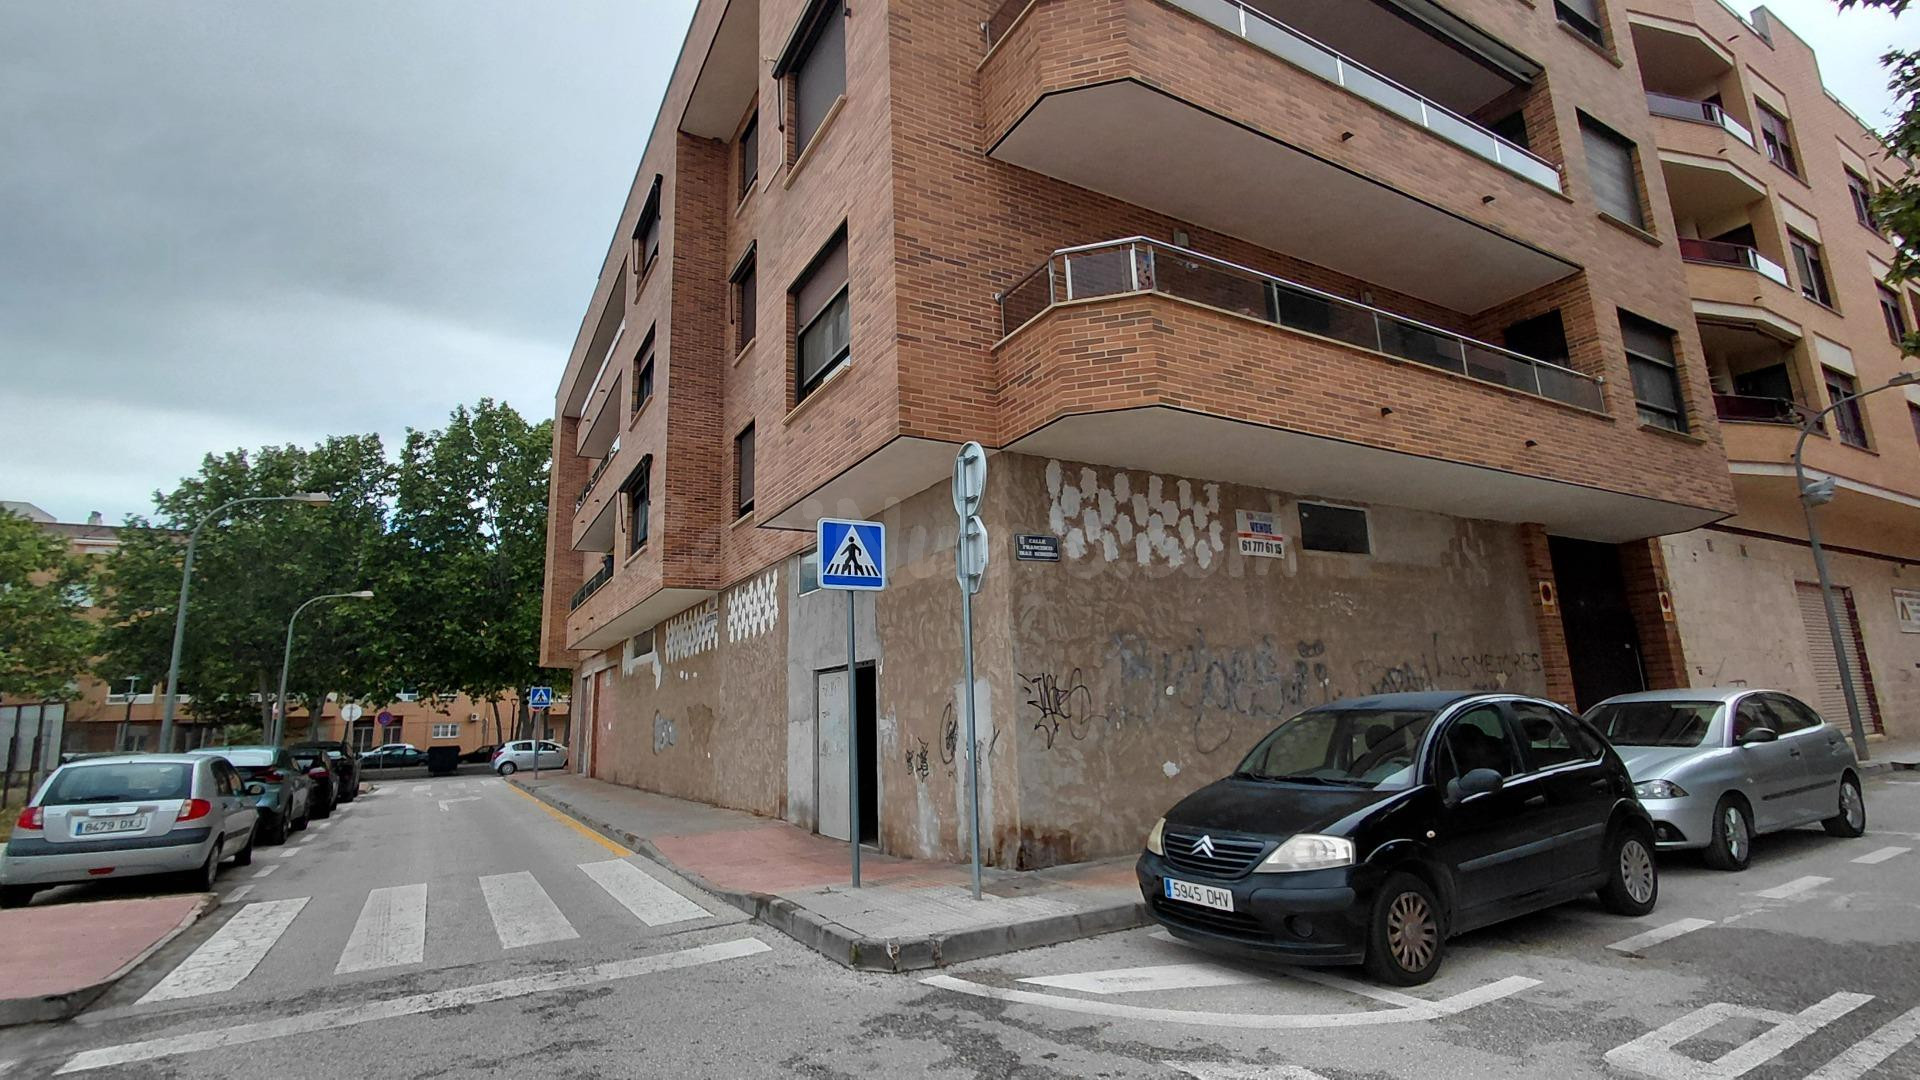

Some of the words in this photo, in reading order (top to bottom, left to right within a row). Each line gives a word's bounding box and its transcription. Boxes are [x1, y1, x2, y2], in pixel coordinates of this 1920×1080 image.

[1249, 521, 1273, 535] VENDE
[1241, 540, 1252, 552] 61
[1173, 882, 1202, 902] 5945
[1206, 888, 1229, 908] DHV
